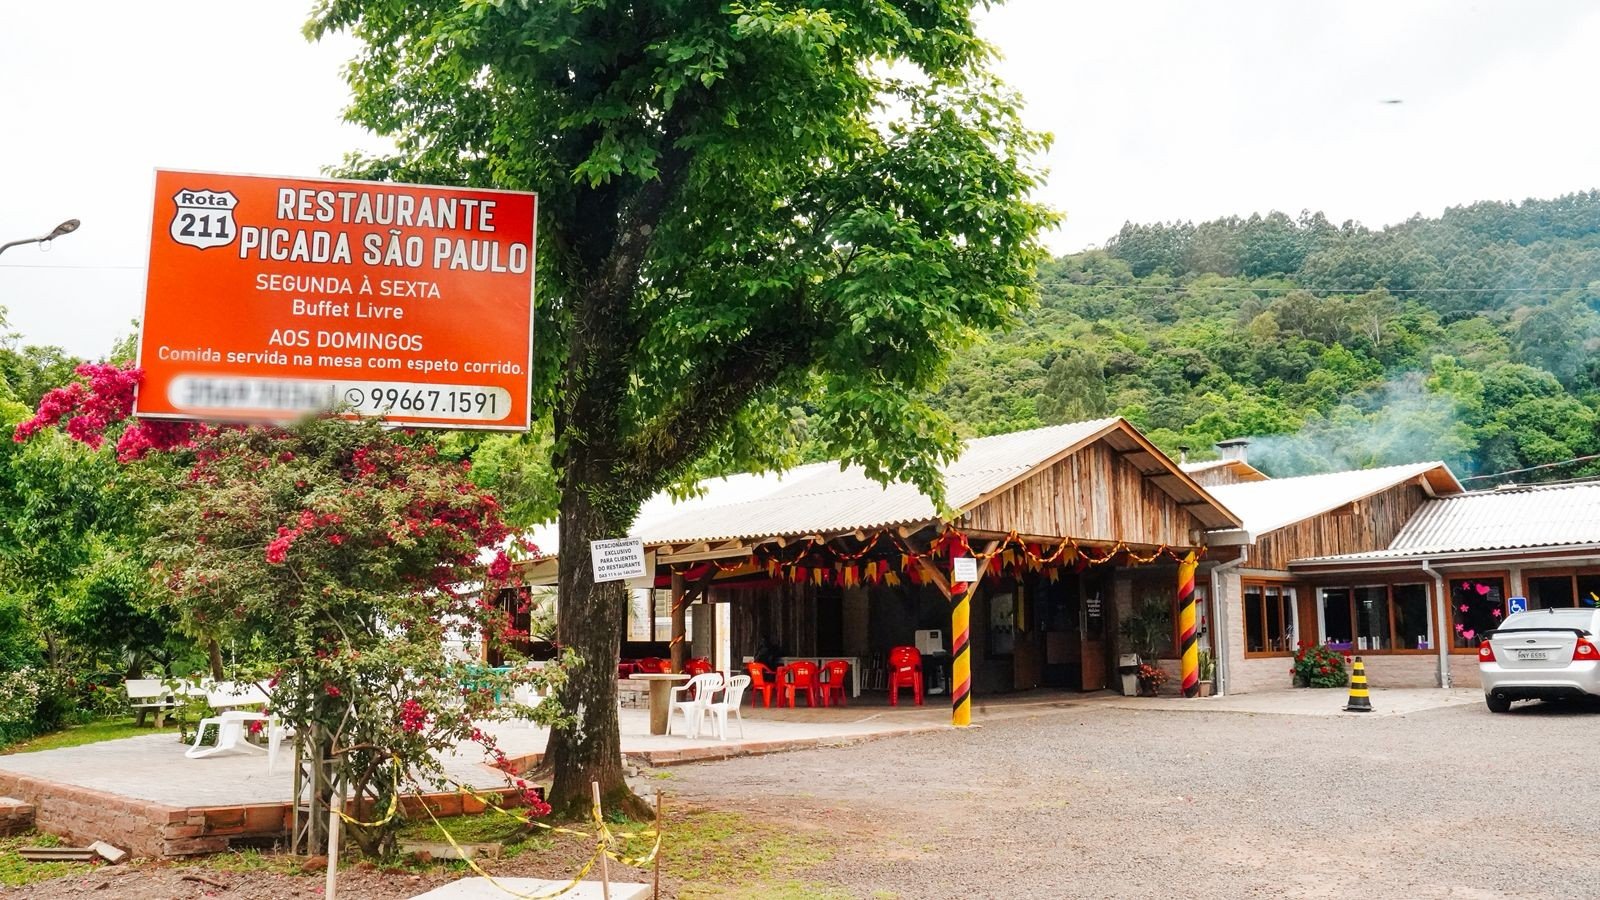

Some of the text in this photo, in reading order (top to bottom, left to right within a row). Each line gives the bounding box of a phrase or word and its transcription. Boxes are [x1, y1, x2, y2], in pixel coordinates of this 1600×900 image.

[181, 193, 228, 206] Rota
[277, 188, 496, 232] RESTAURANTE
[180, 213, 229, 239] 211
[239, 226, 527, 274] PICADA SÃO PAULO
[255, 274, 441, 299] SEGUNDA À SEXTA
[292, 299, 404, 319] Buffet Livre
[268, 329, 423, 351] AOS DOMINGOS
[158, 346, 525, 375] Comida servida na mesa com espeto corrido.
[370, 387, 497, 414] 99667.1591
[595, 540, 639, 550] ESTACIONAMENTO
[604, 548, 632, 556] EXCLUSIVO
[606, 562, 640, 570] RESTAURANTE
